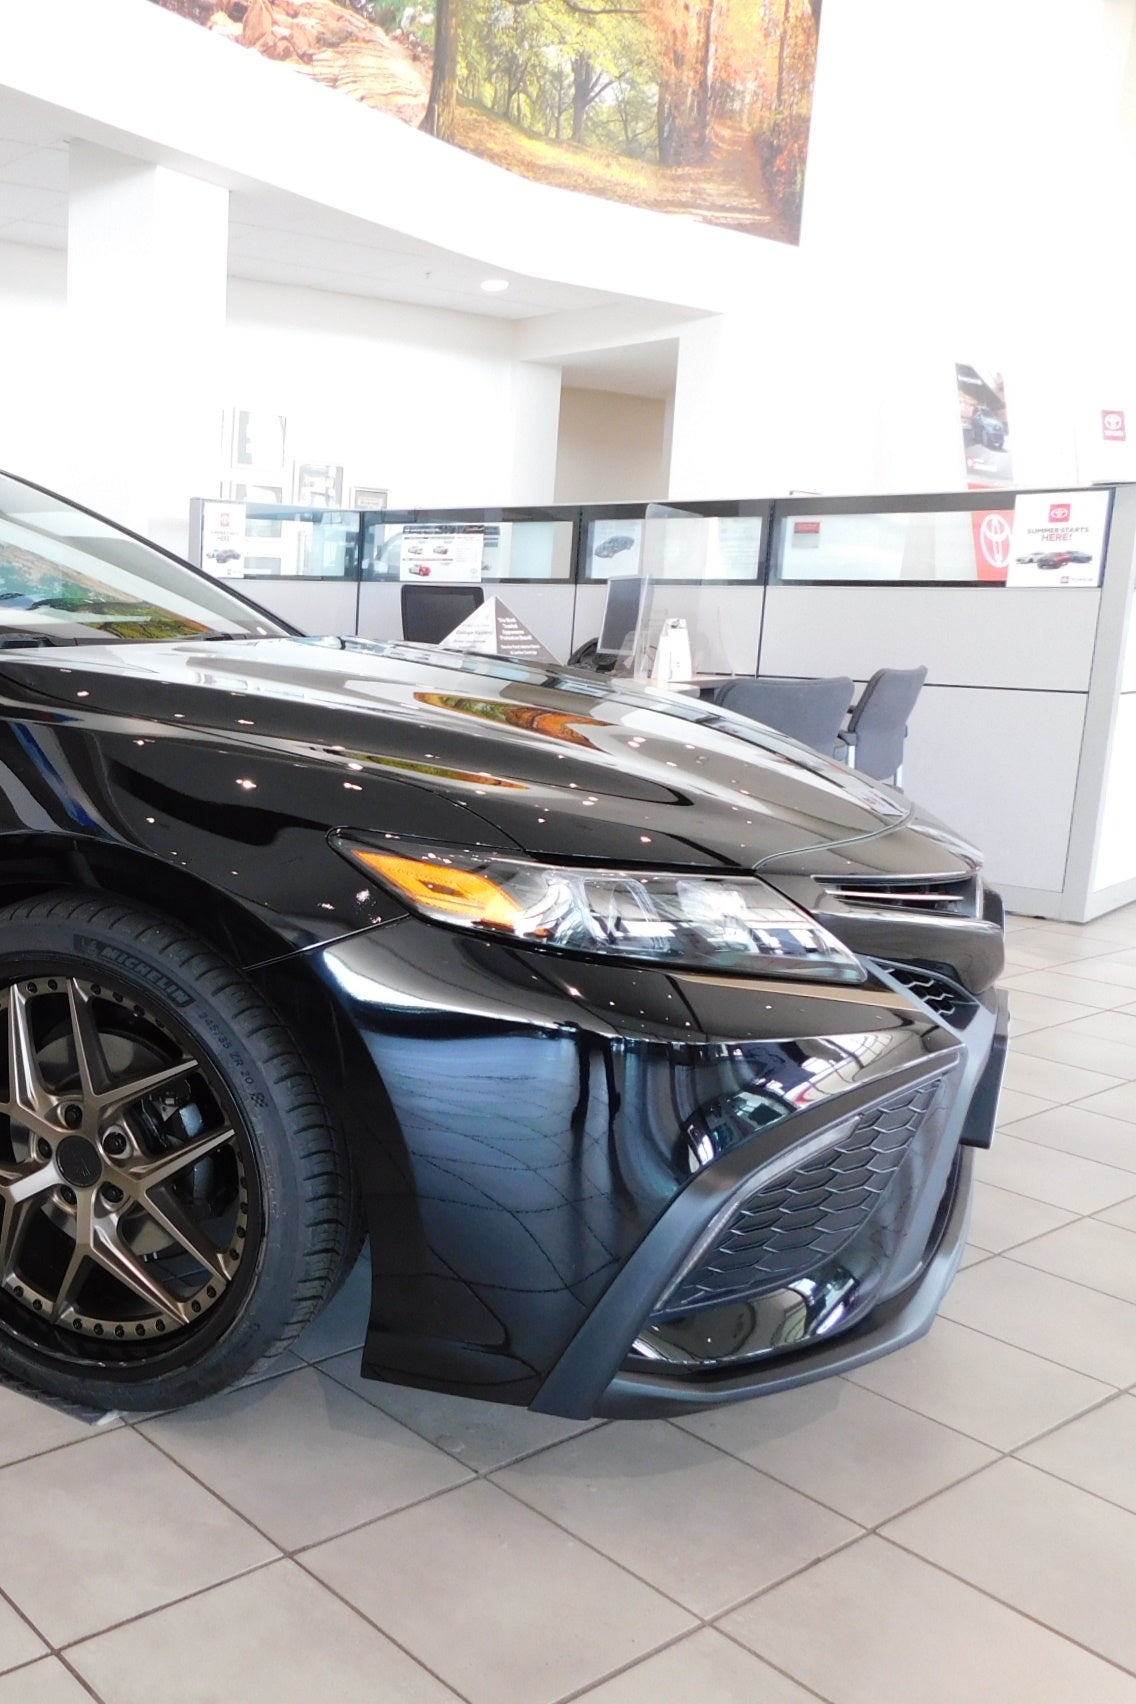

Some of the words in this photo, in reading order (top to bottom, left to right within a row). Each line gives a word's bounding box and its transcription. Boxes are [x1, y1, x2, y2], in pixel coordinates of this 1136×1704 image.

[1041, 533, 1072, 541] HERE!
[99, 944, 193, 1005] MICHELIN
[240, 1070, 254, 1084] 20
